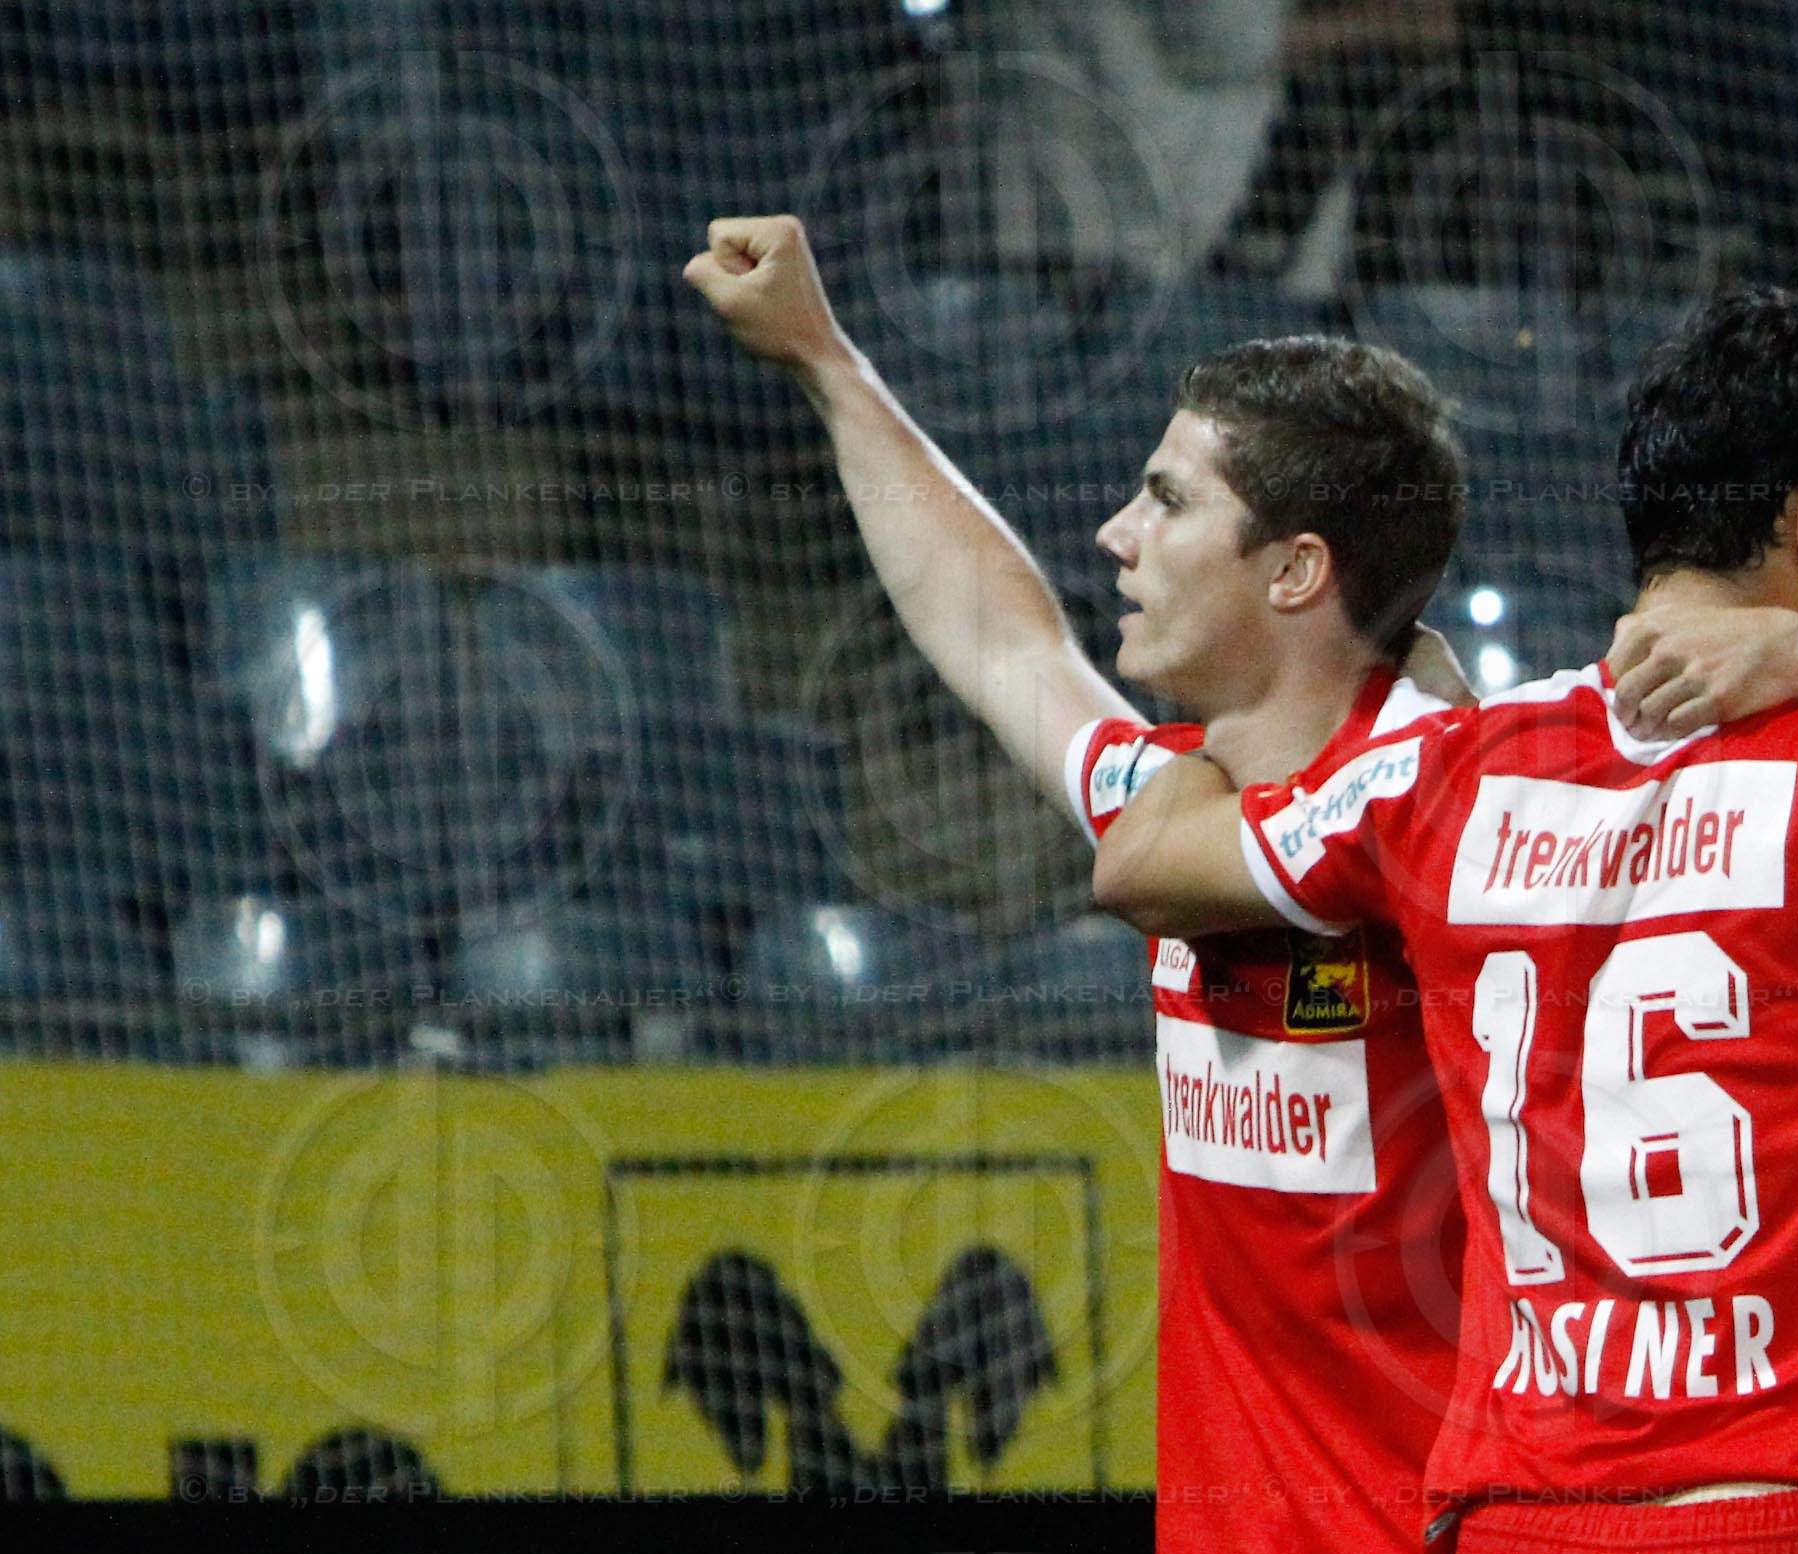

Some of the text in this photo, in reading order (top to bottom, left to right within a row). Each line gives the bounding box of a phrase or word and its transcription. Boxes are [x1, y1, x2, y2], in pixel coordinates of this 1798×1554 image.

[1292, 1001, 1361, 1021] ADMIRA
[1165, 1052, 1333, 1164] trenkwalder
[1472, 930, 1760, 1286] 16
